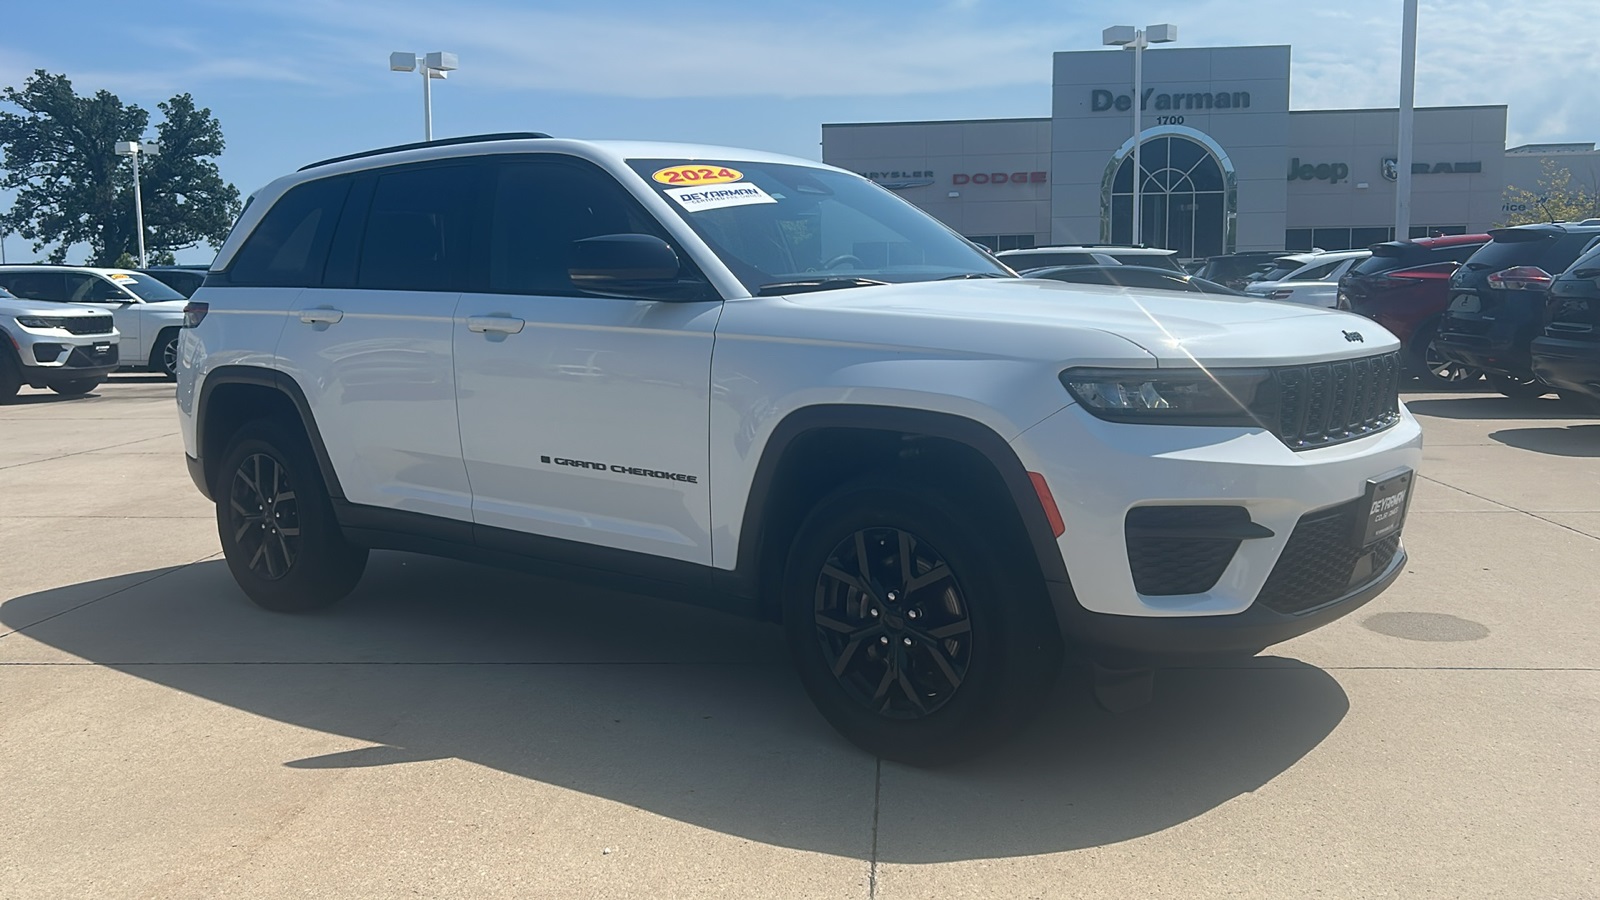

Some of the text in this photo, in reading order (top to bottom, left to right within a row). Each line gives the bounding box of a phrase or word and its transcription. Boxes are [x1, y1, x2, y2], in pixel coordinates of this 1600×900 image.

[1091, 88, 1250, 112] DeYarman
[1156, 115, 1184, 125] 1700
[1287, 157, 1348, 184] Jeep
[1411, 161, 1481, 174] RAM
[663, 168, 737, 183] 2024
[863, 171, 934, 179] RYSLER
[952, 171, 1047, 185] DODGE
[680, 188, 759, 202] DEYARMAN
[554, 457, 698, 484] GRAND CHEROKEE
